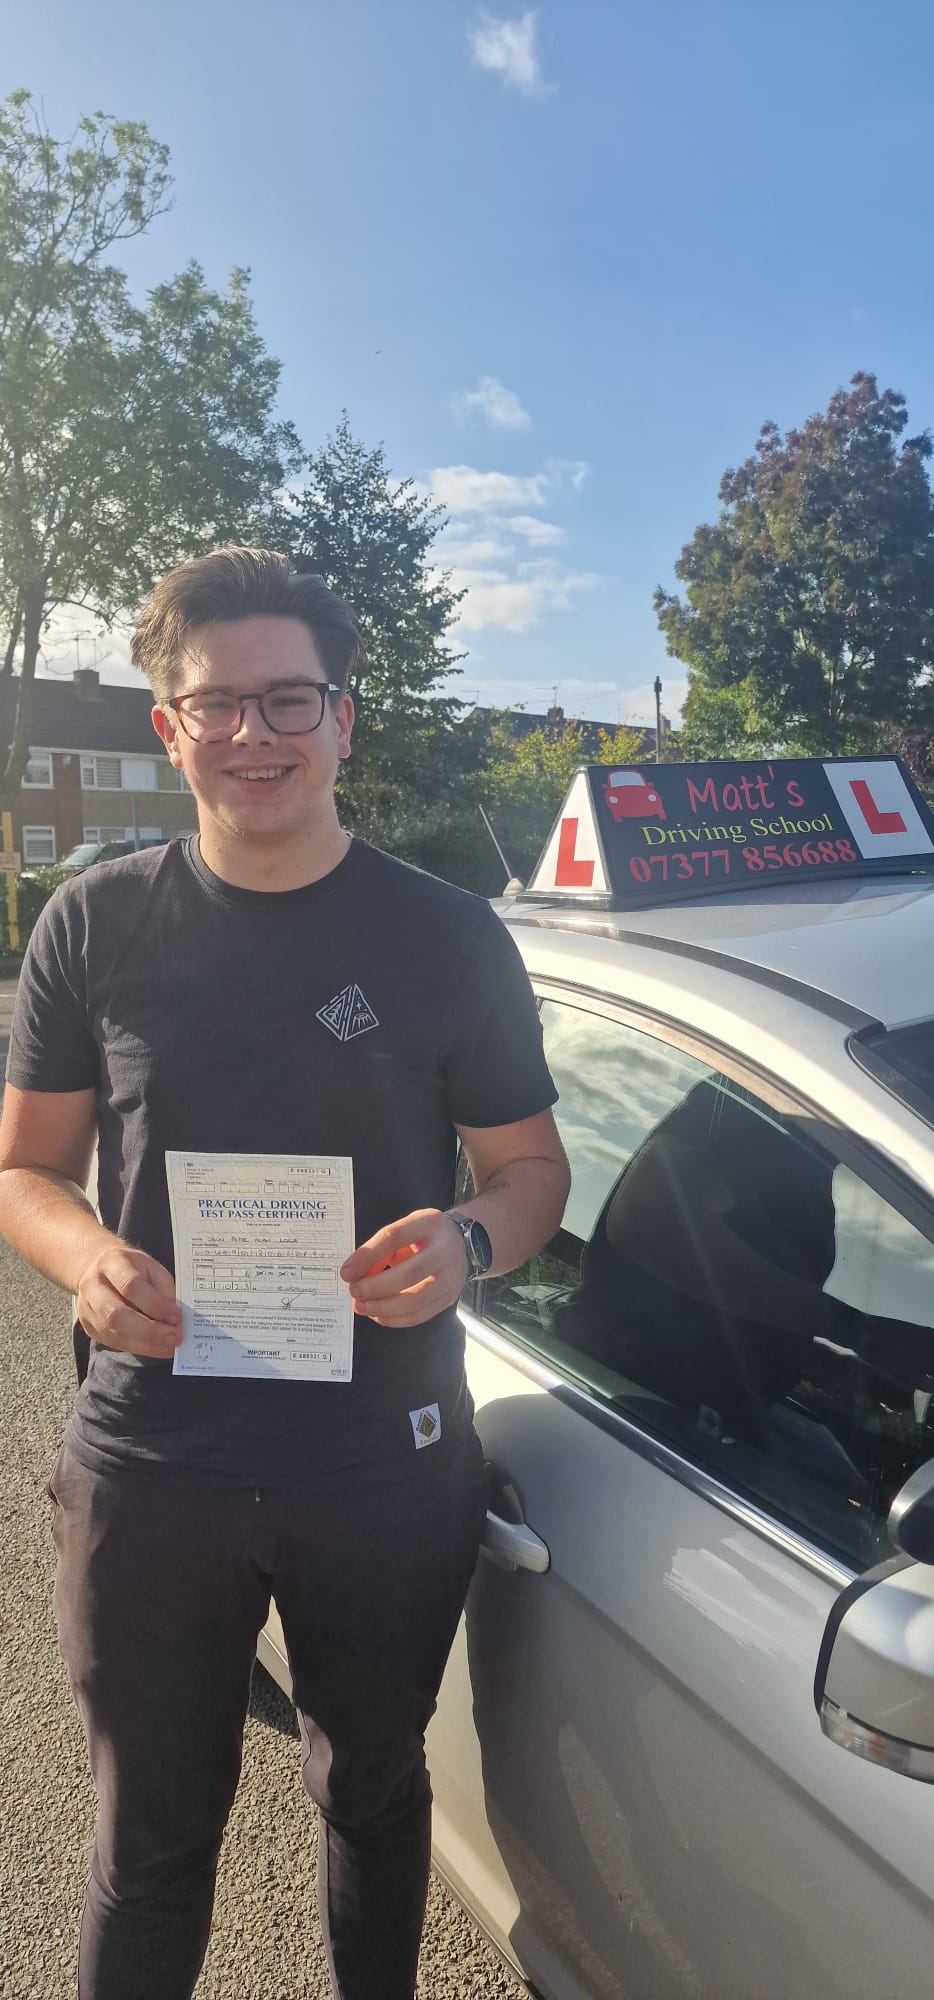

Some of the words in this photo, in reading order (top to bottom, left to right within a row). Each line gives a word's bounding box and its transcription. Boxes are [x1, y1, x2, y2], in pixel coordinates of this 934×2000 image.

[686, 764, 805, 814] Matt's
[848, 780, 908, 835] L
[640, 820, 747, 846] Driving
[749, 813, 835, 838] School
[555, 818, 595, 887] L
[629, 848, 731, 883] 07377
[742, 839, 858, 872] 856688
[198, 1199, 268, 1209] PRACTICAL
[270, 1200, 326, 1210] DRIVING
[200, 1210, 225, 1218] TEST
[228, 1210, 255, 1219] PASS
[258, 1210, 326, 1220] CERTIFICATE
[247, 1349, 280, 1357] IMPORTANT
